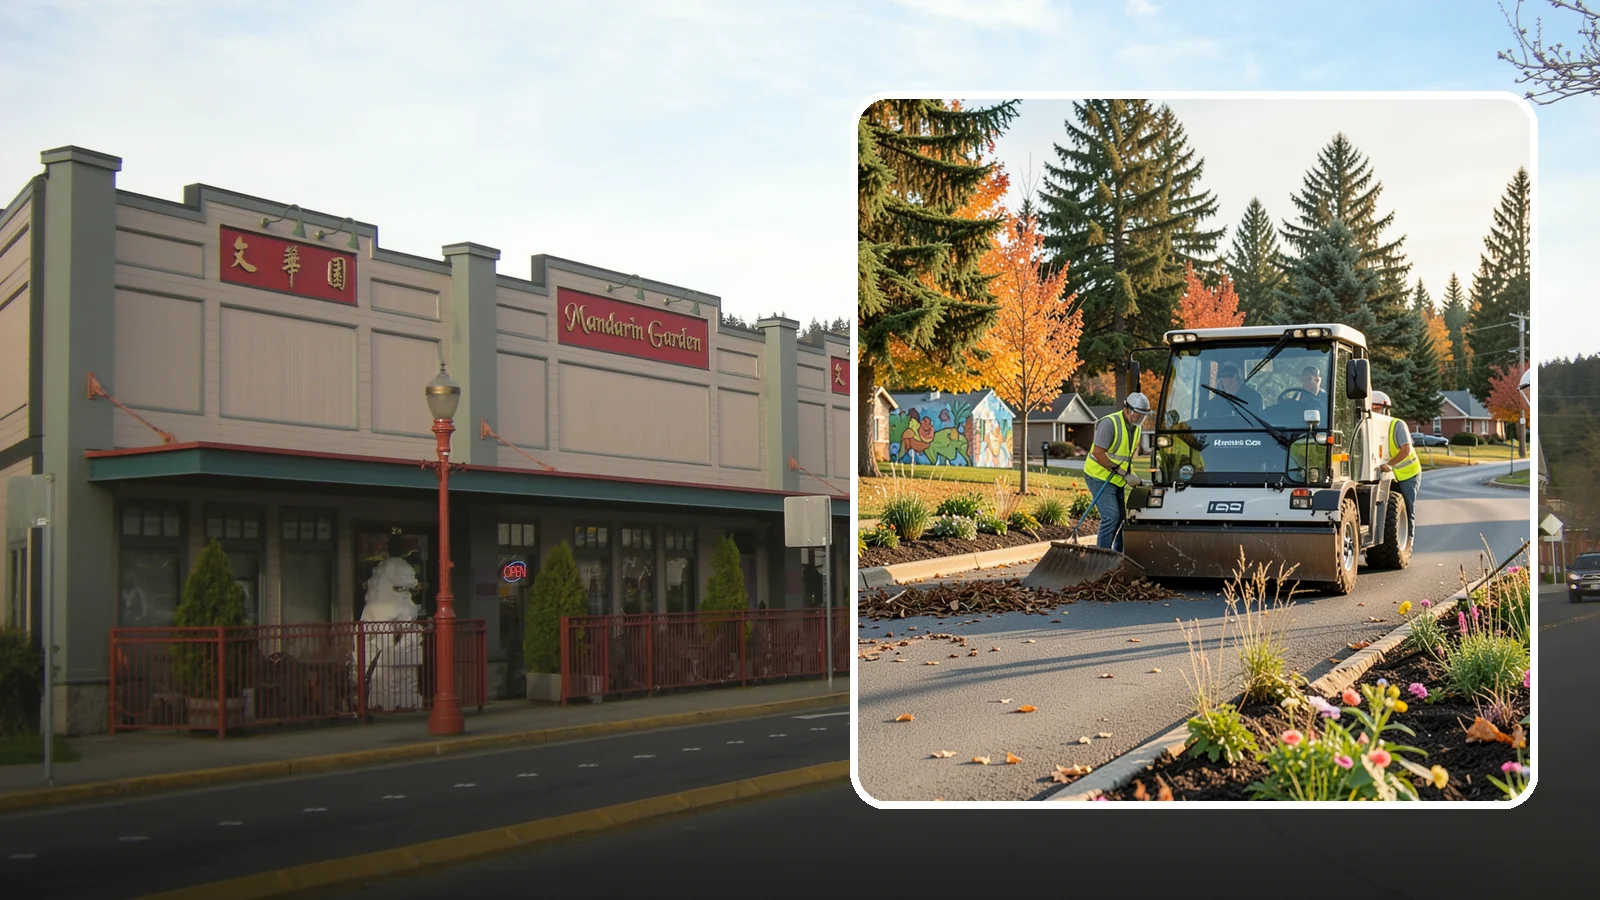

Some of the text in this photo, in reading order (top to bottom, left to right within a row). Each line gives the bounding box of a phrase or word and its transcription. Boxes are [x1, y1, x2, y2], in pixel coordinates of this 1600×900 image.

[564, 302, 701, 352] Mandarin Garden
[391, 526, 402, 535] 28
[503, 565, 527, 578] OPEN
